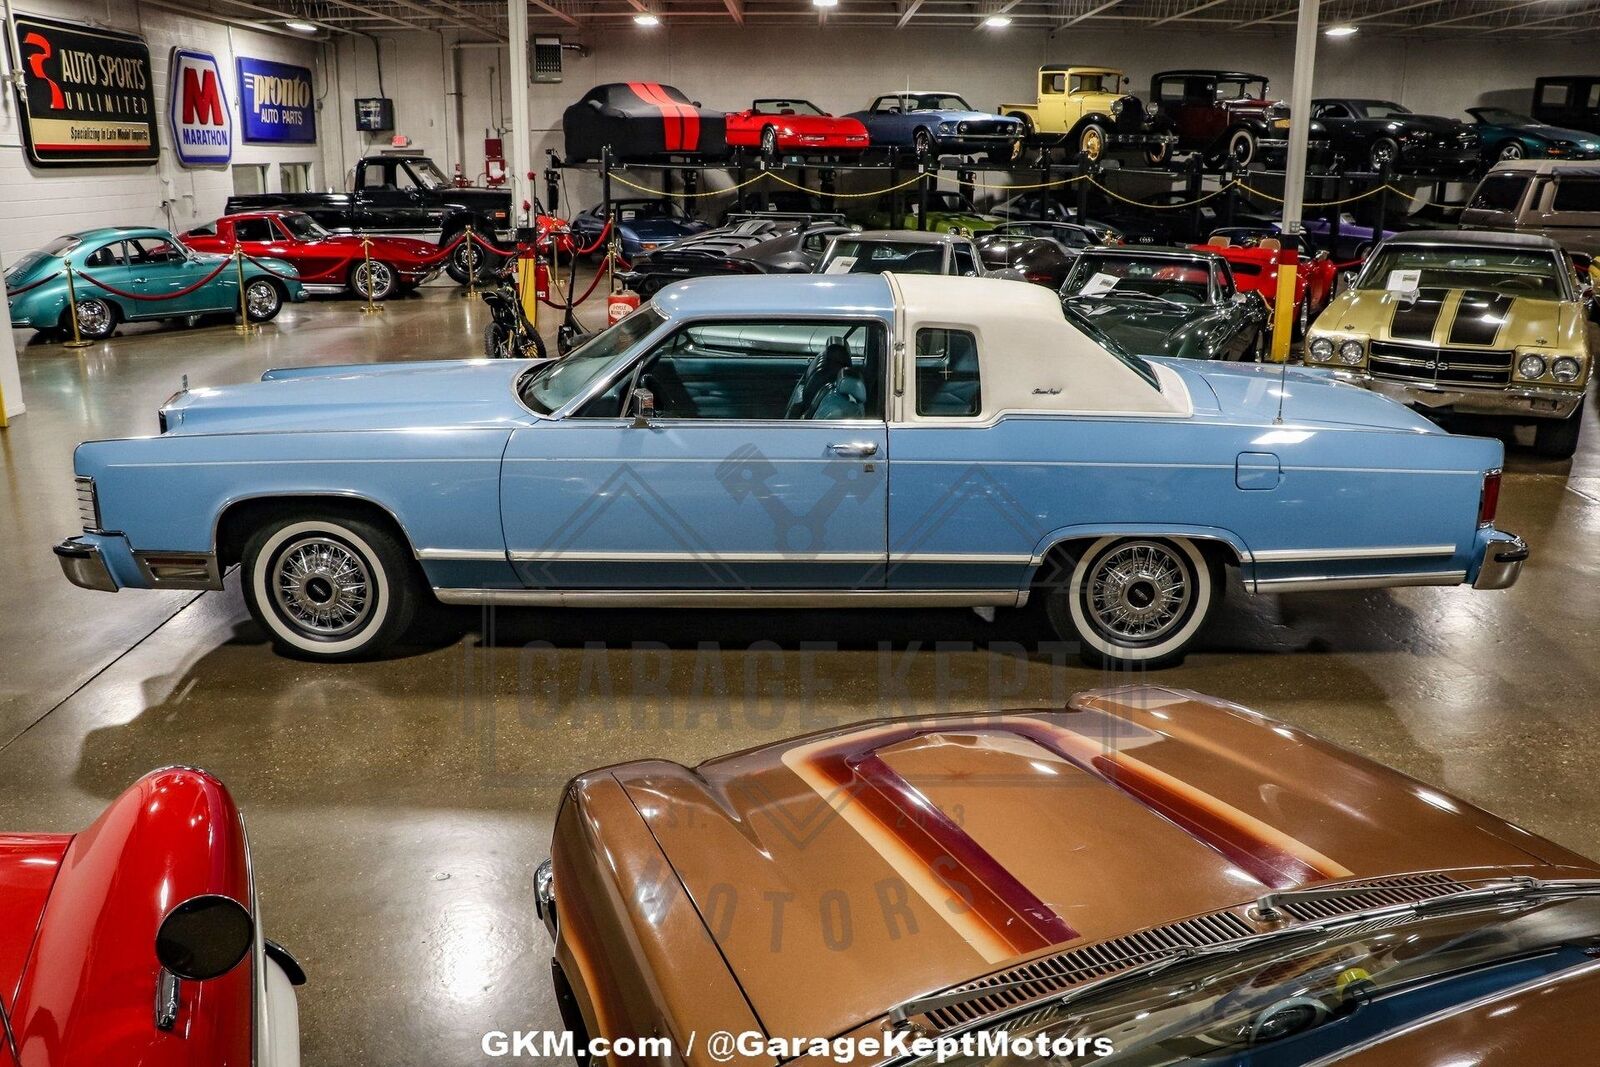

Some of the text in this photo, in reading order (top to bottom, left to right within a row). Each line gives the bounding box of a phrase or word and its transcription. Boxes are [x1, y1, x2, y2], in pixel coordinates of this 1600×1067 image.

[60, 49, 146, 90] AUTO SPORTS
[64, 91, 148, 115] UNLIMITED
[253, 74, 310, 113] pronto
[261, 109, 303, 125] AUTO PARTS
[70, 126, 100, 141] Specializing
[182, 128, 228, 145] MARATHON
